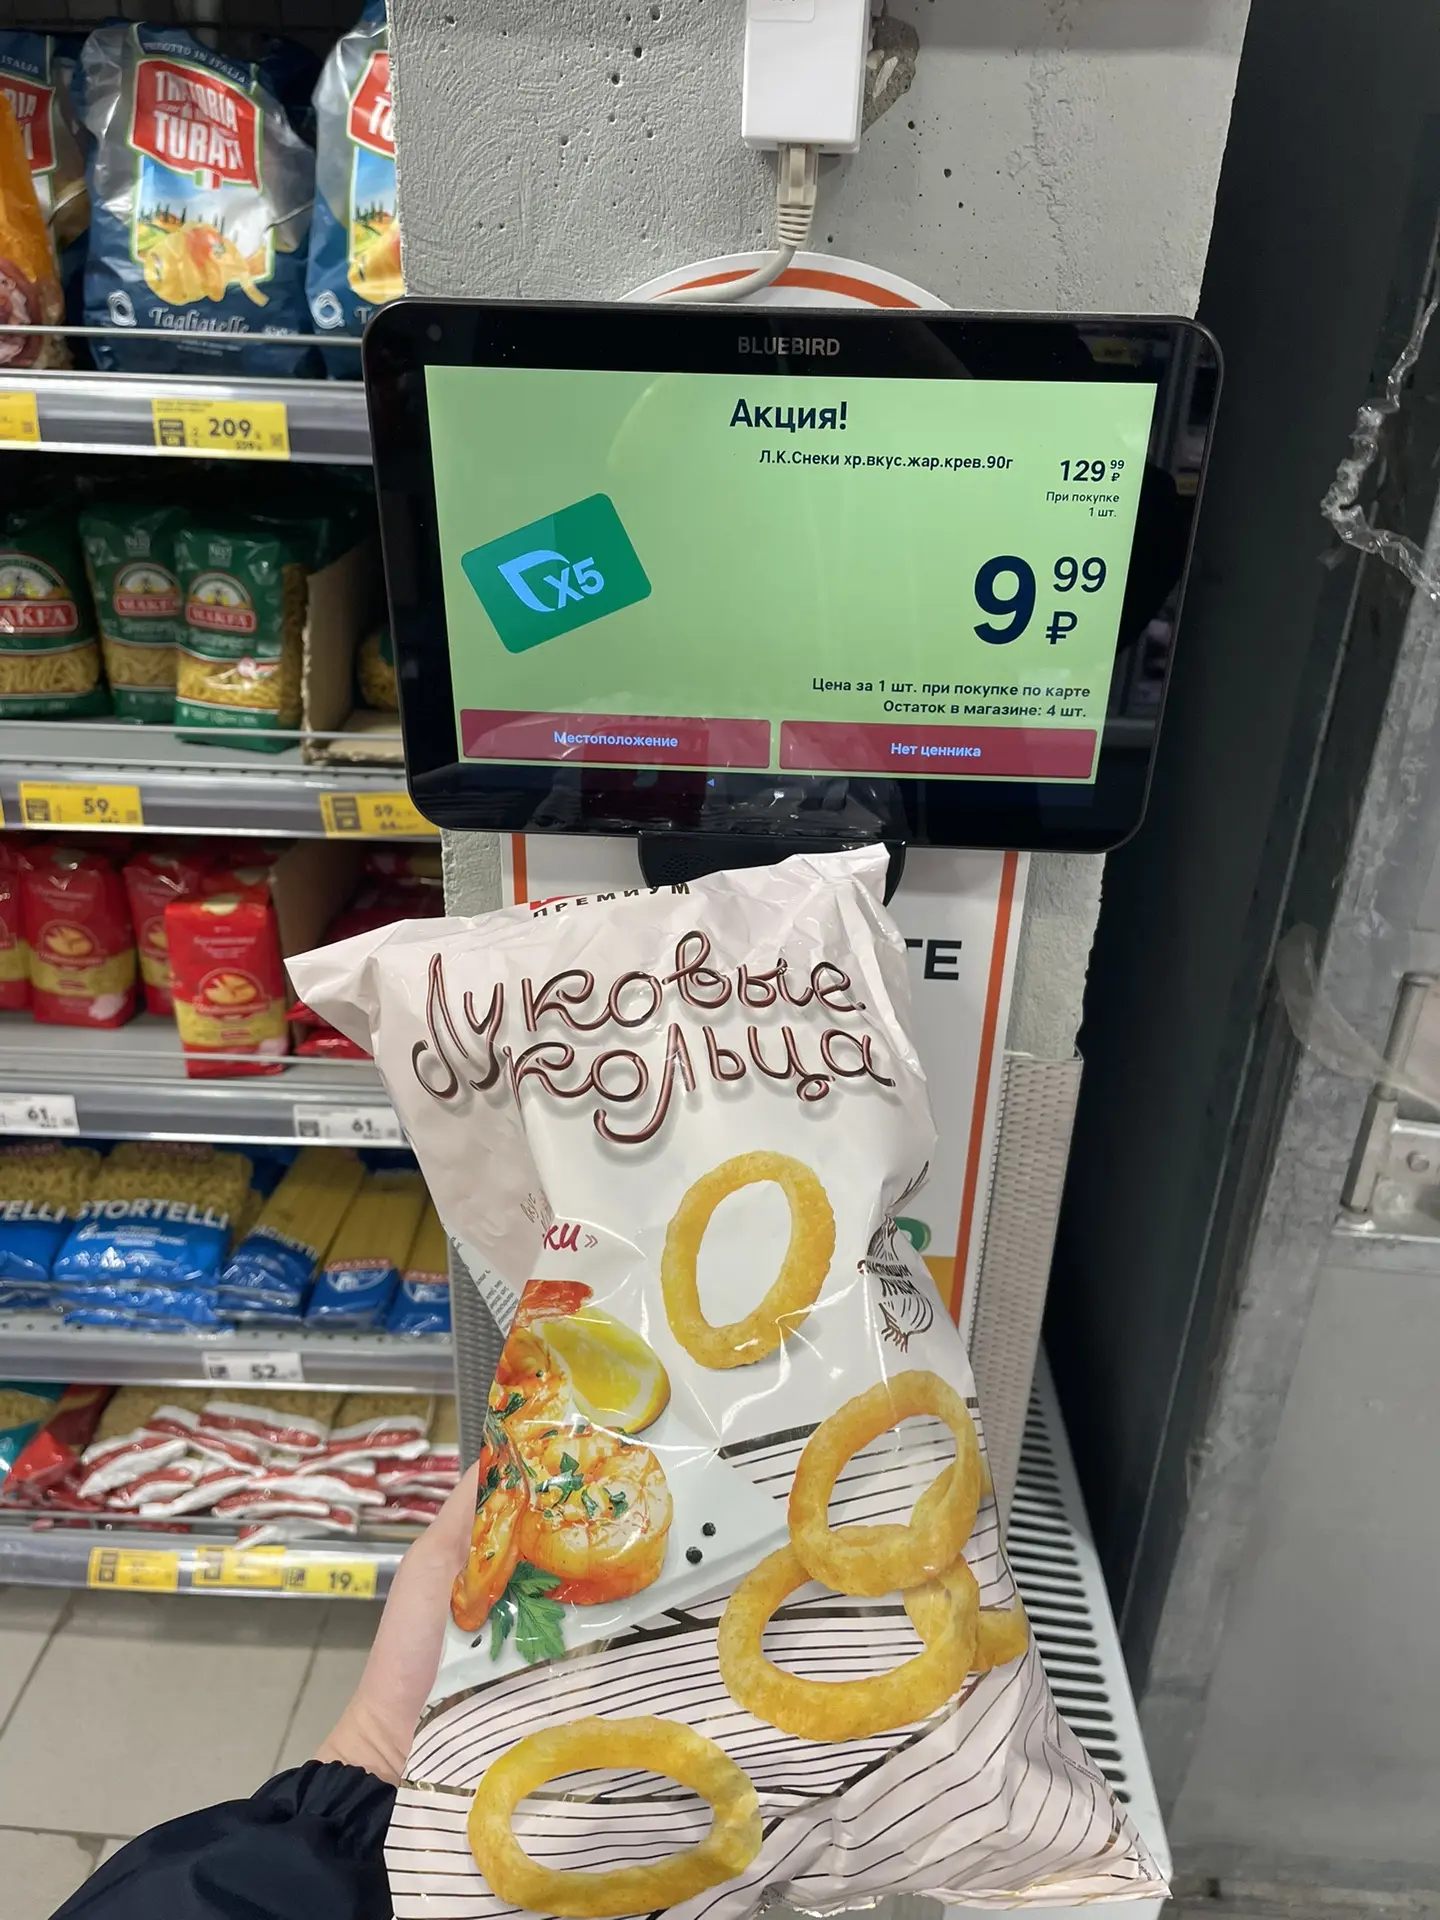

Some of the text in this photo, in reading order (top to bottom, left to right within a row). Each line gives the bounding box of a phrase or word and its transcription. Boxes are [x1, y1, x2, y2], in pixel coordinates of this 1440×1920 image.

[738, 336, 841, 356] BLUEBIRD
[729, 398, 848, 433] Акция!
[208, 418, 252, 438] 209
[759, 450, 1014, 472] Л.К.Снеки хр.вкус.жар.крев.90г
[1060, 459, 1125, 482] 129 99
[1046, 491, 1120, 504] При покупке
[1089, 507, 1117, 518] 1 шт.
[973, 555, 1107, 645] 9 99
[812, 677, 1091, 700] Цена за 1 шт. при покупке по карте
[883, 700, 1087, 718] Остаток в магазине: 4 шт.
[553, 731, 679, 748] Местоположение
[890, 742, 982, 758] Нет ценника
[83, 797, 109, 815] 59
[411, 930, 867, 1100] Луковые
[503, 1022, 896, 1144] кольца
[251, 1363, 277, 1380] 52
[329, 1571, 353, 1590] 19
